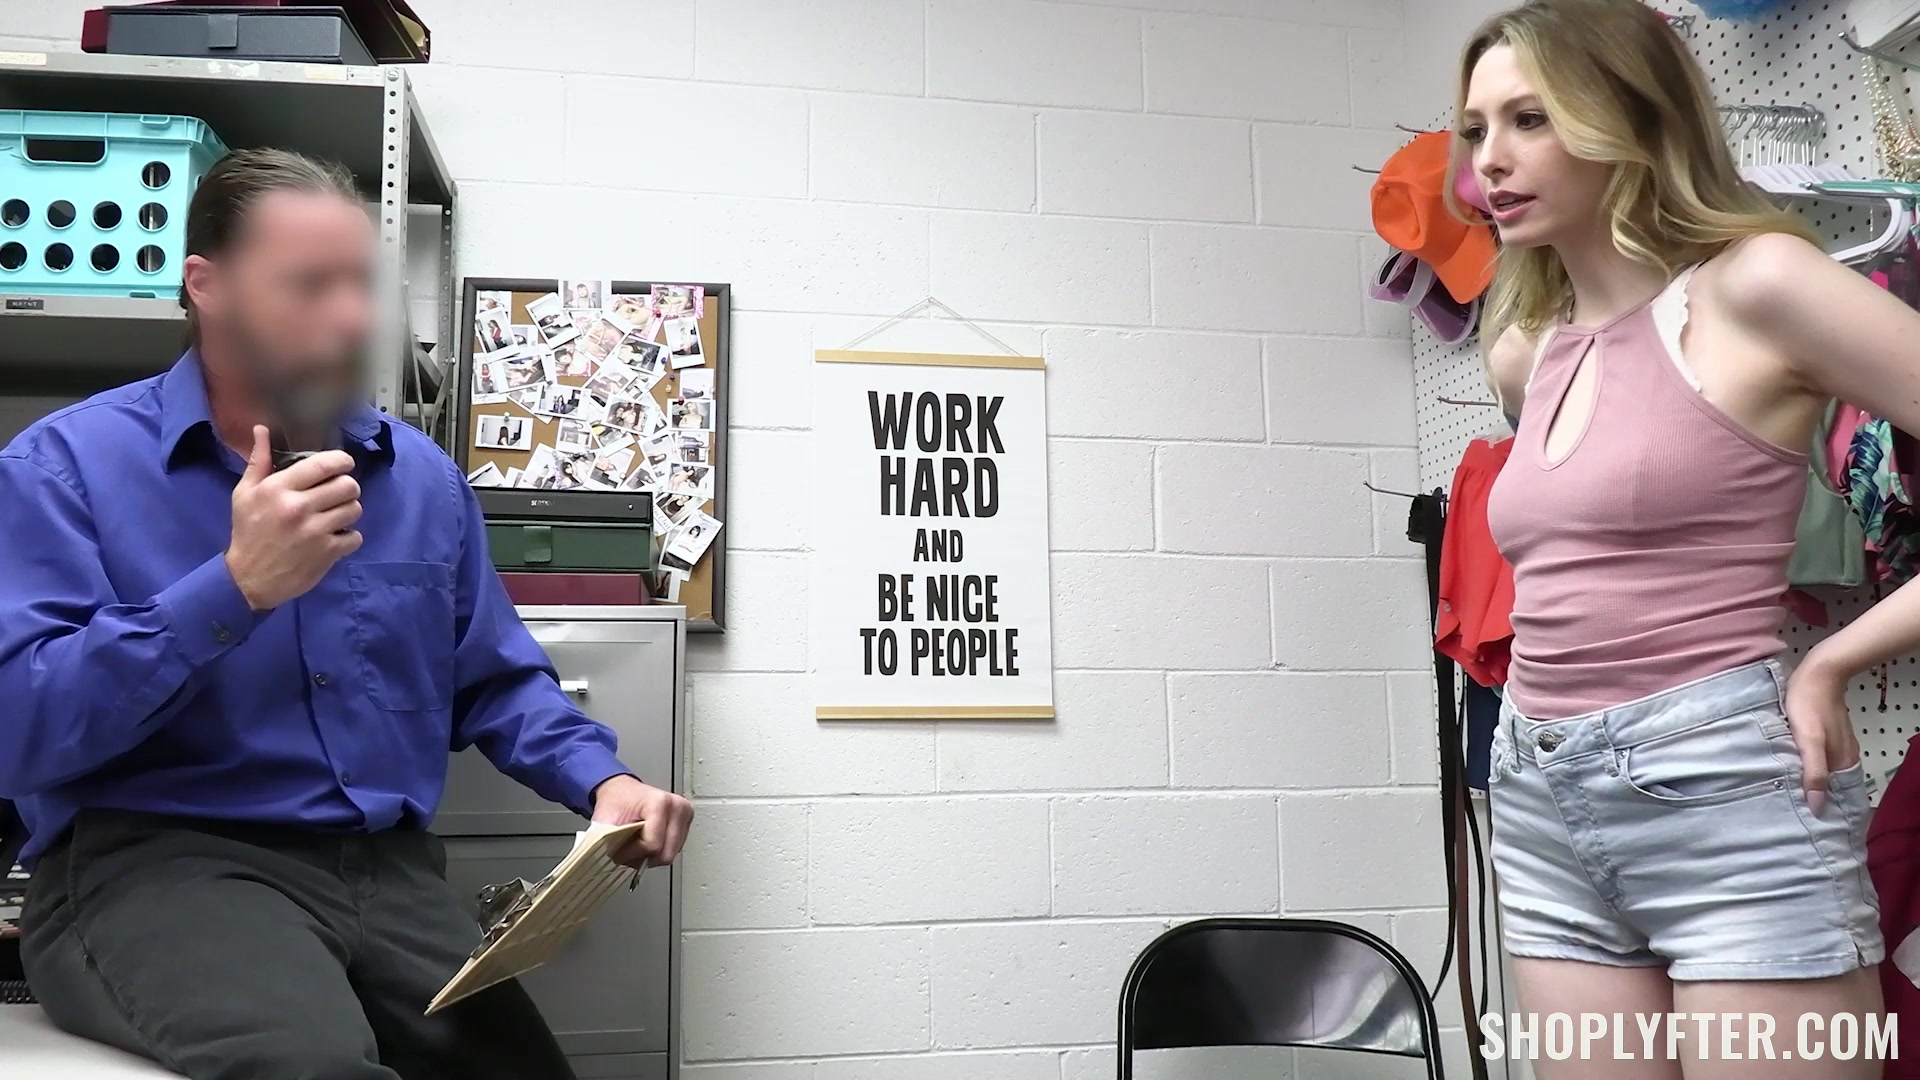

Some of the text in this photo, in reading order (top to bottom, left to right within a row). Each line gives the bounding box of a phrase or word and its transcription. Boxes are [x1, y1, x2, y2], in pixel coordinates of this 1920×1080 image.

[868, 391, 1005, 454] WORK
[881, 456, 999, 518] HARD
[913, 529, 963, 563] AND
[878, 574, 999, 623] BE NICE
[860, 629, 1019, 677] TO PEOPLE
